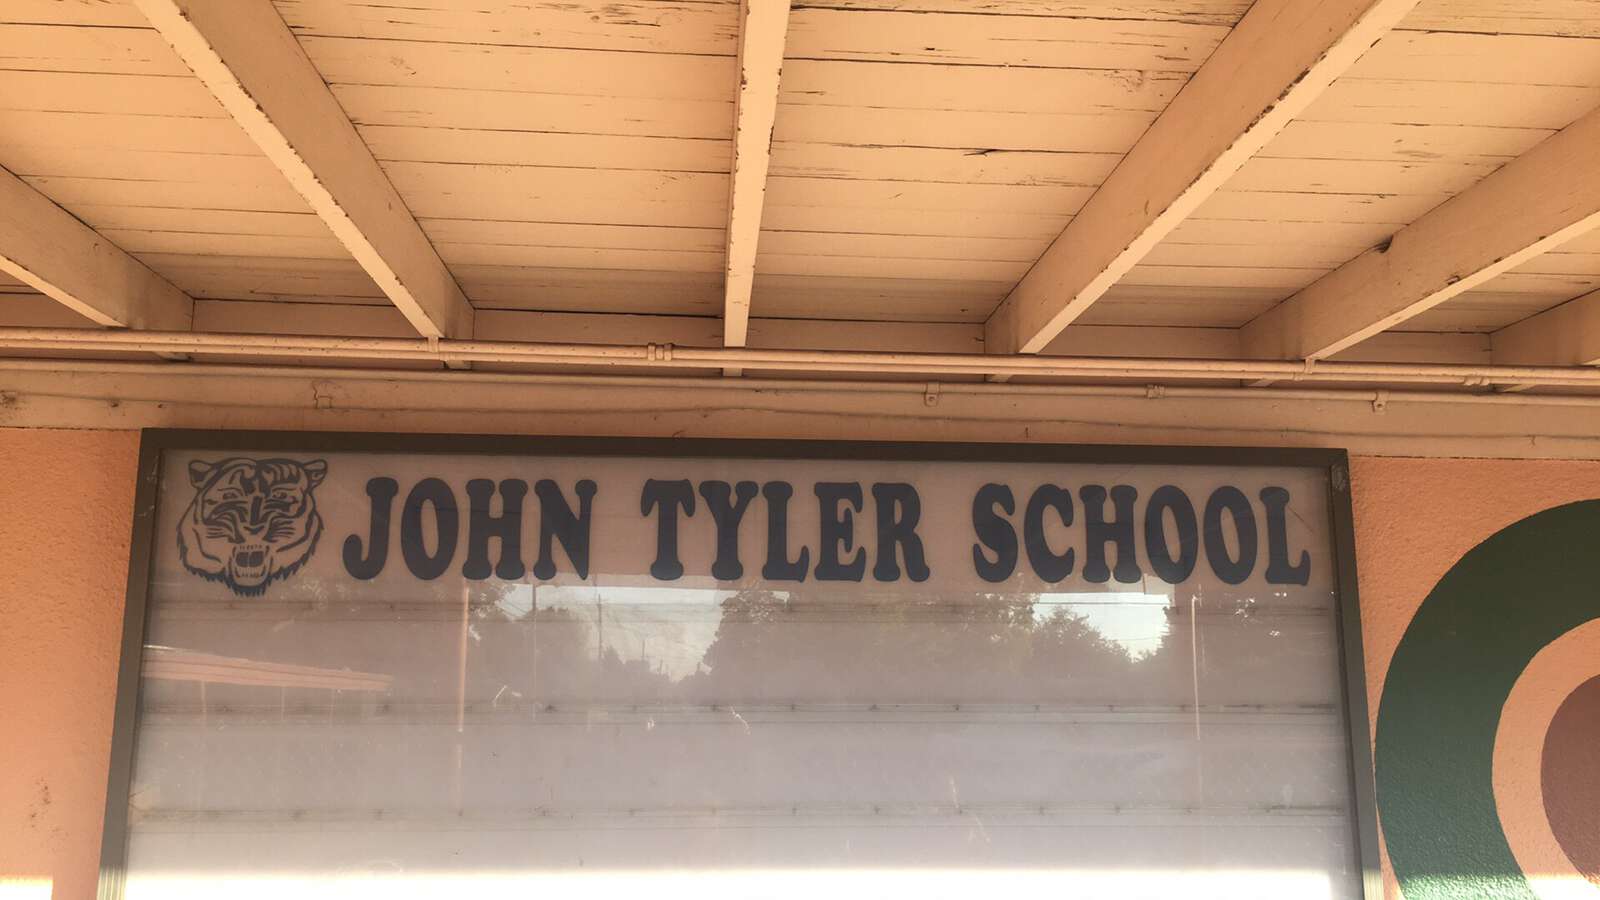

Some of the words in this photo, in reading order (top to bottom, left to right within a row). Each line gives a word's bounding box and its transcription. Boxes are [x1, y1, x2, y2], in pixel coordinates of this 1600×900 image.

[341, 475, 599, 582] JOHN
[639, 478, 931, 584] TYLER
[971, 482, 1312, 587] SCHOOL
